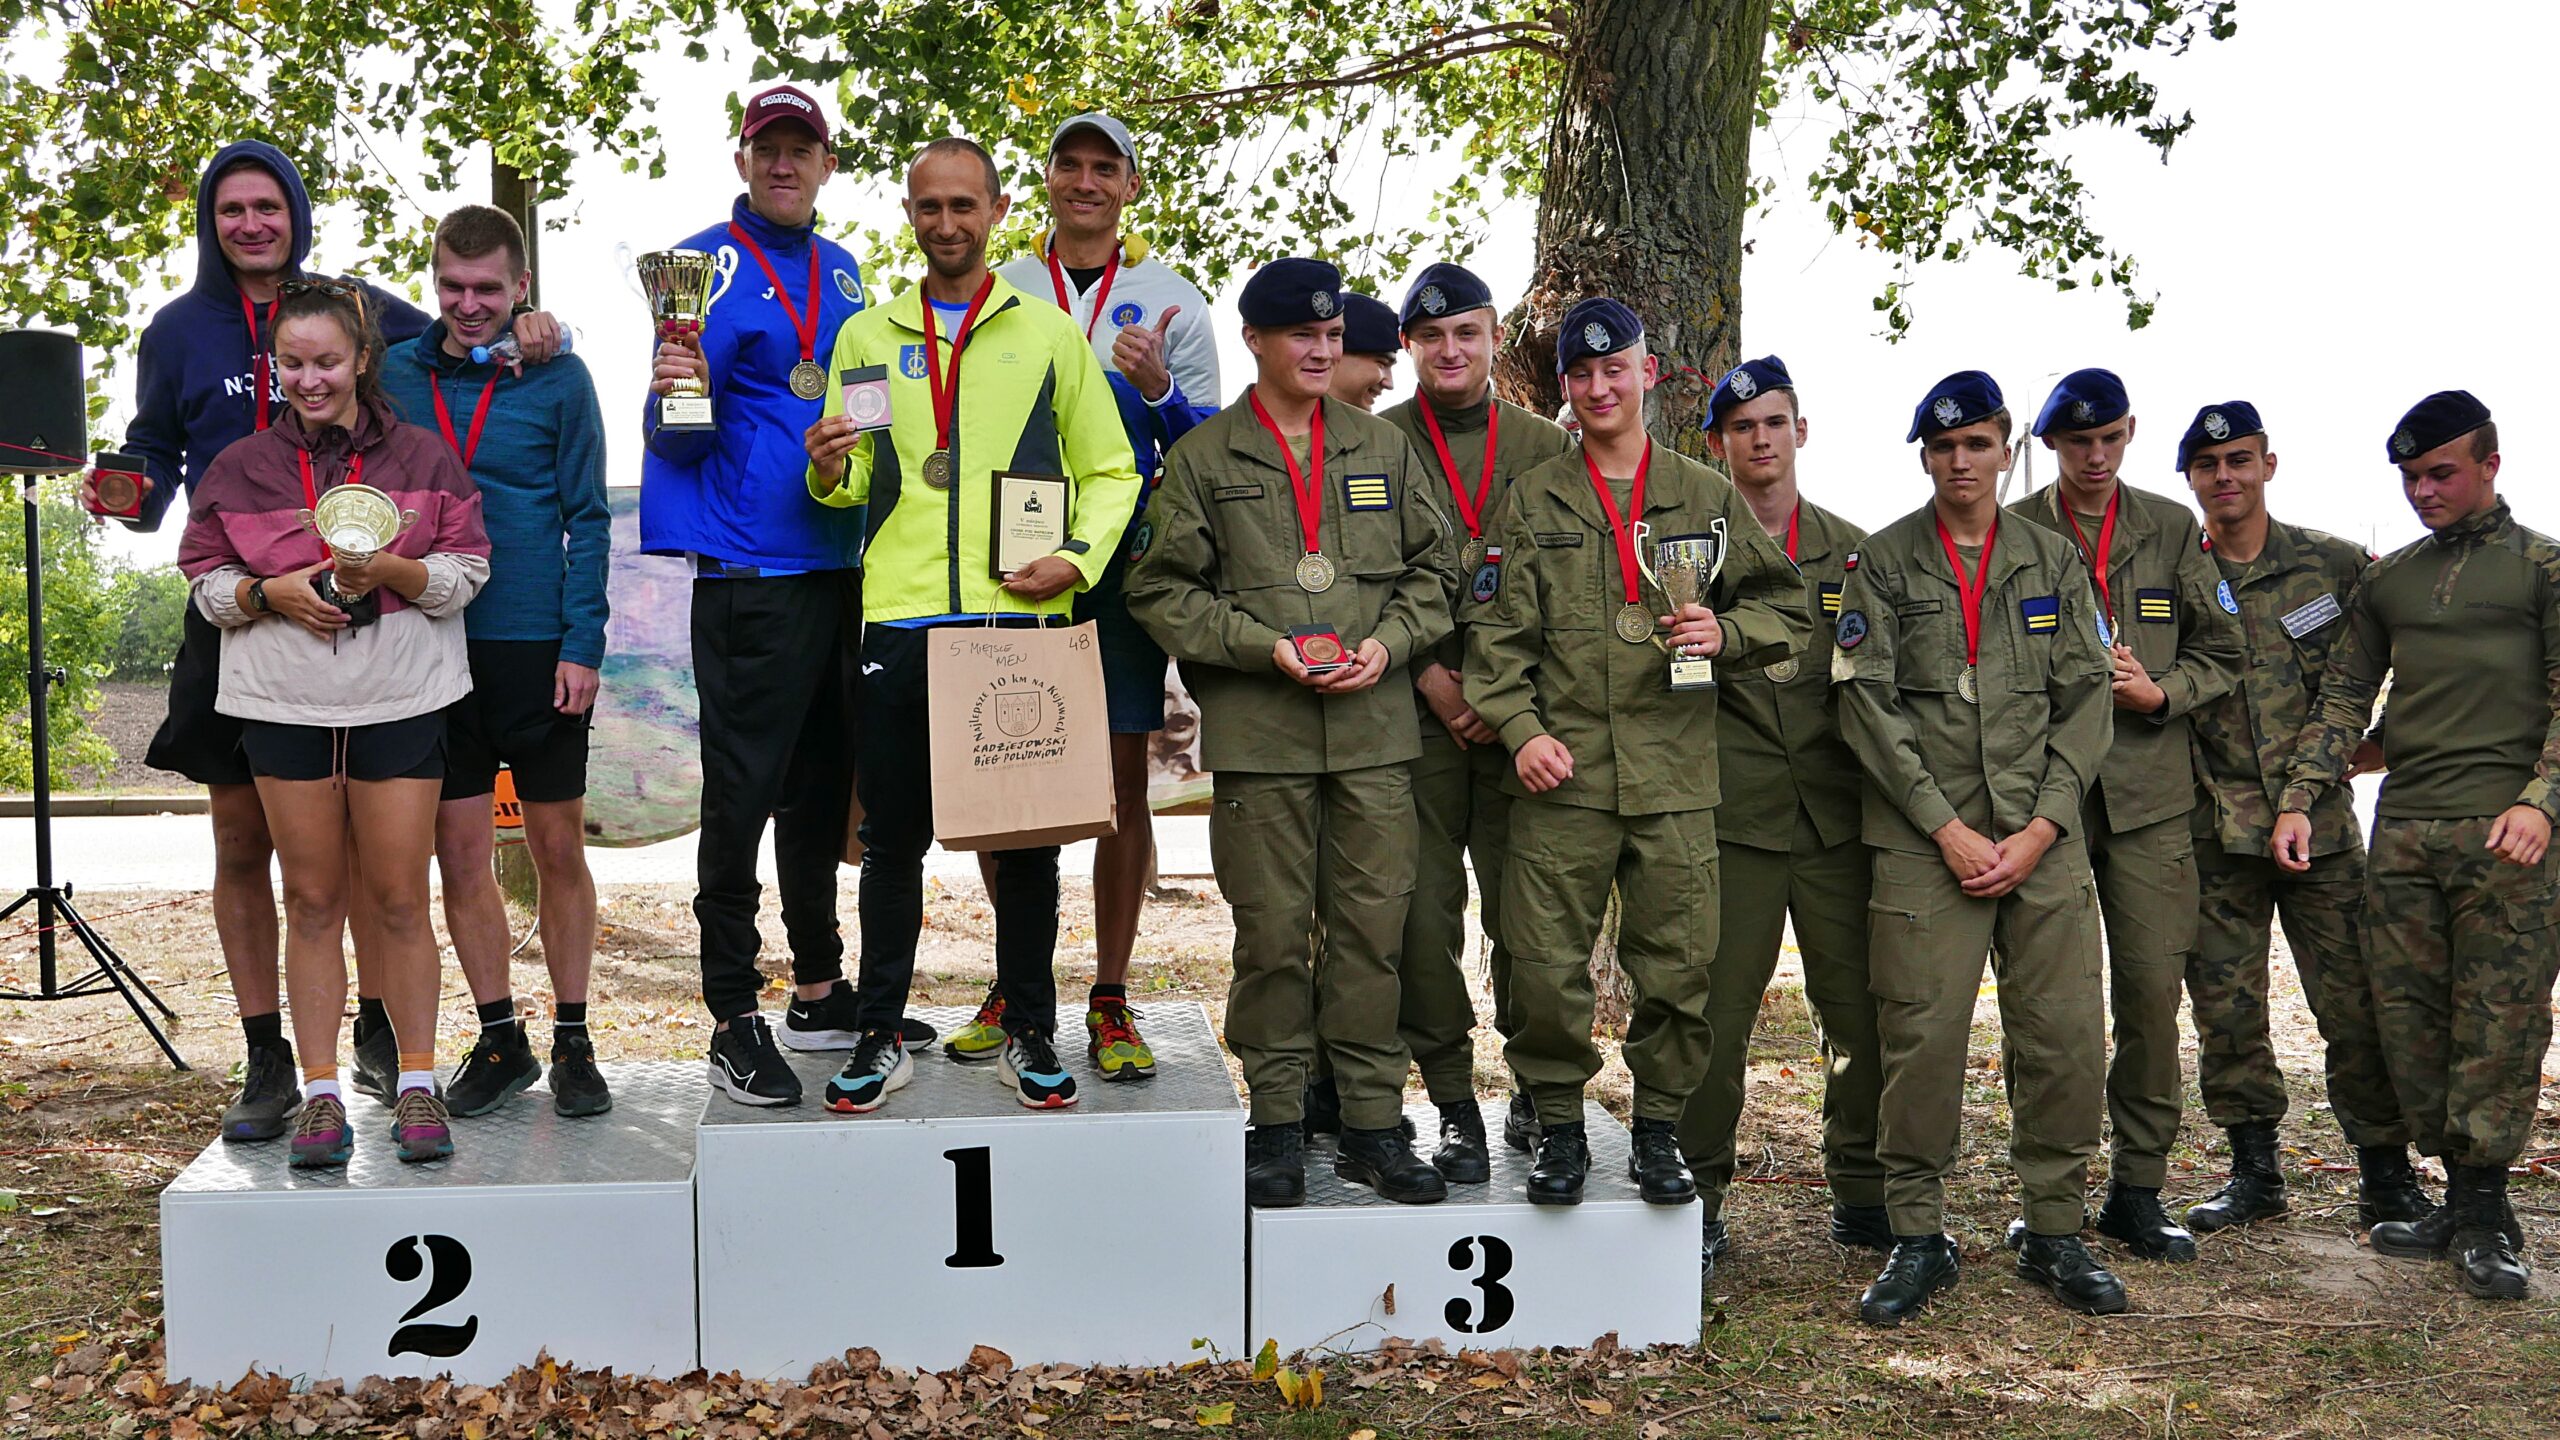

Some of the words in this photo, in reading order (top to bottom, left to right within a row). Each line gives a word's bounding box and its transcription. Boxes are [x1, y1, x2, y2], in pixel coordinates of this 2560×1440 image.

[950, 640, 966, 657] 5
[1069, 633, 1090, 651] 48
[996, 653, 1028, 667] MEN
[989, 677, 1007, 690] 10
[943, 1145, 1005, 1267] 1
[1444, 1235, 1515, 1334] 3
[385, 1234, 479, 1358] 2
